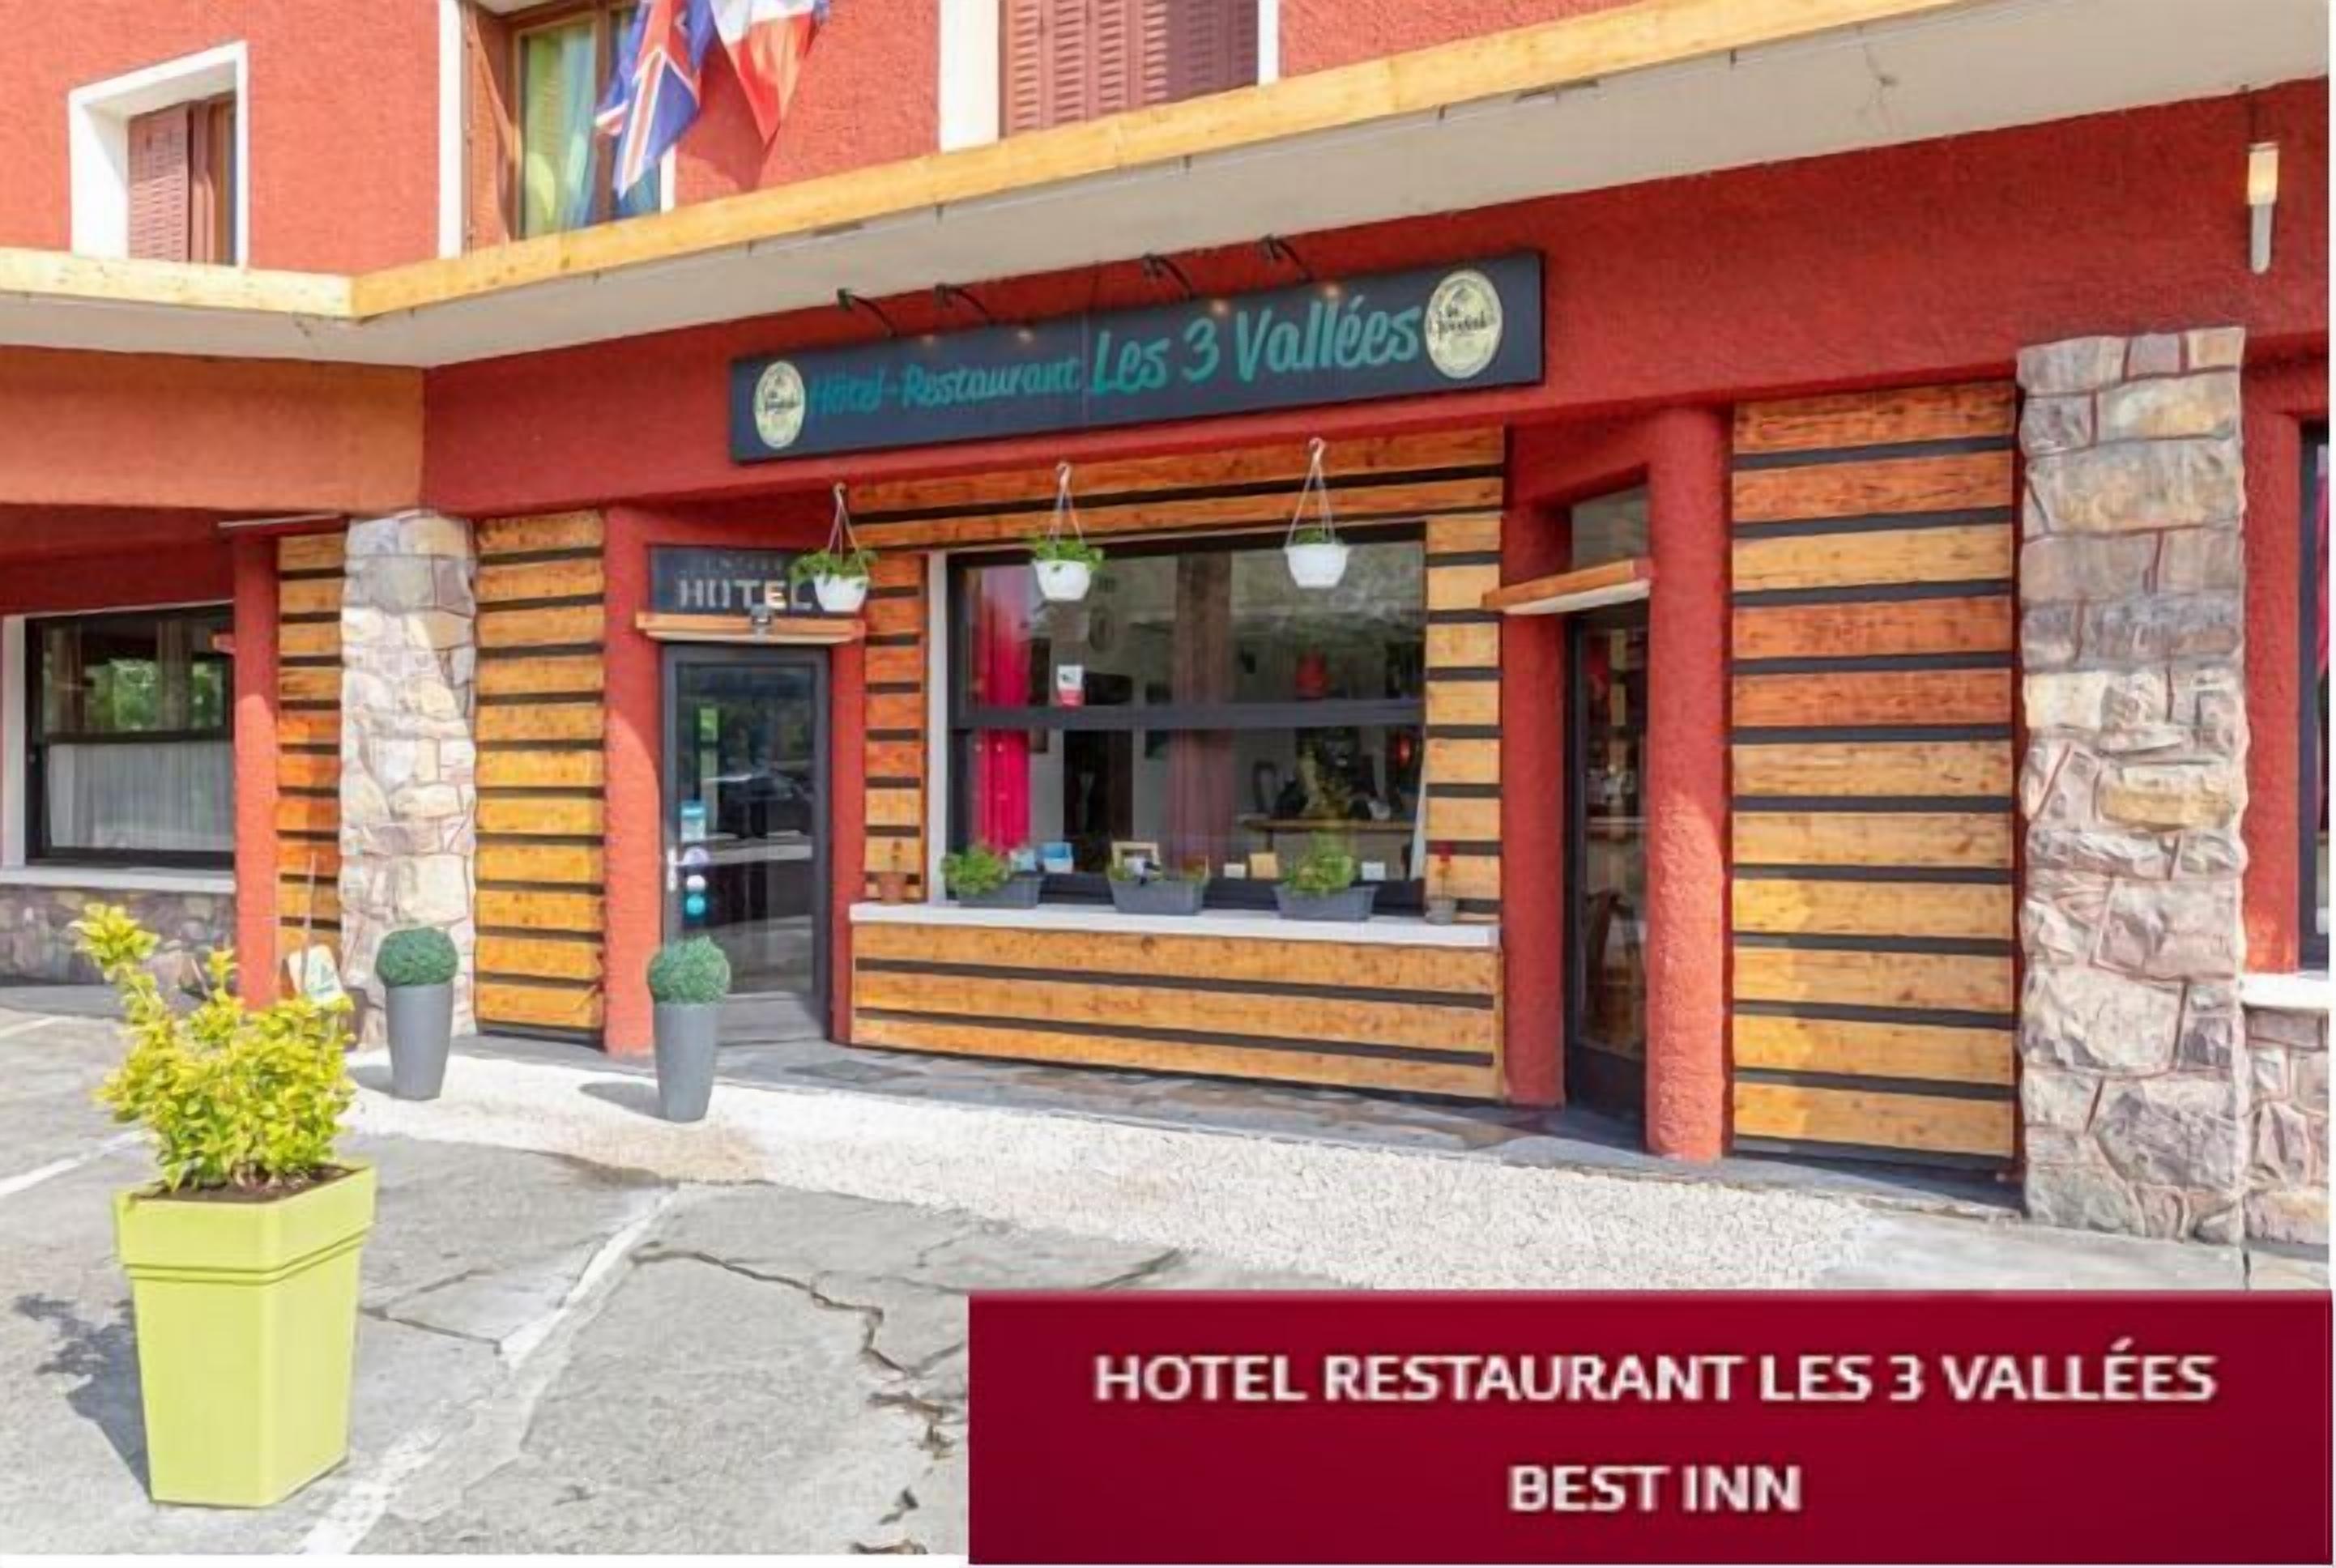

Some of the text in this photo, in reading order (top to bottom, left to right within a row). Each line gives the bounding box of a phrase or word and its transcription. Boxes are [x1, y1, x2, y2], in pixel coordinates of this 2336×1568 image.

[1093, 330, 1171, 396] Les
[1182, 317, 1220, 382] 3
[1237, 295, 1422, 383] Vallées
